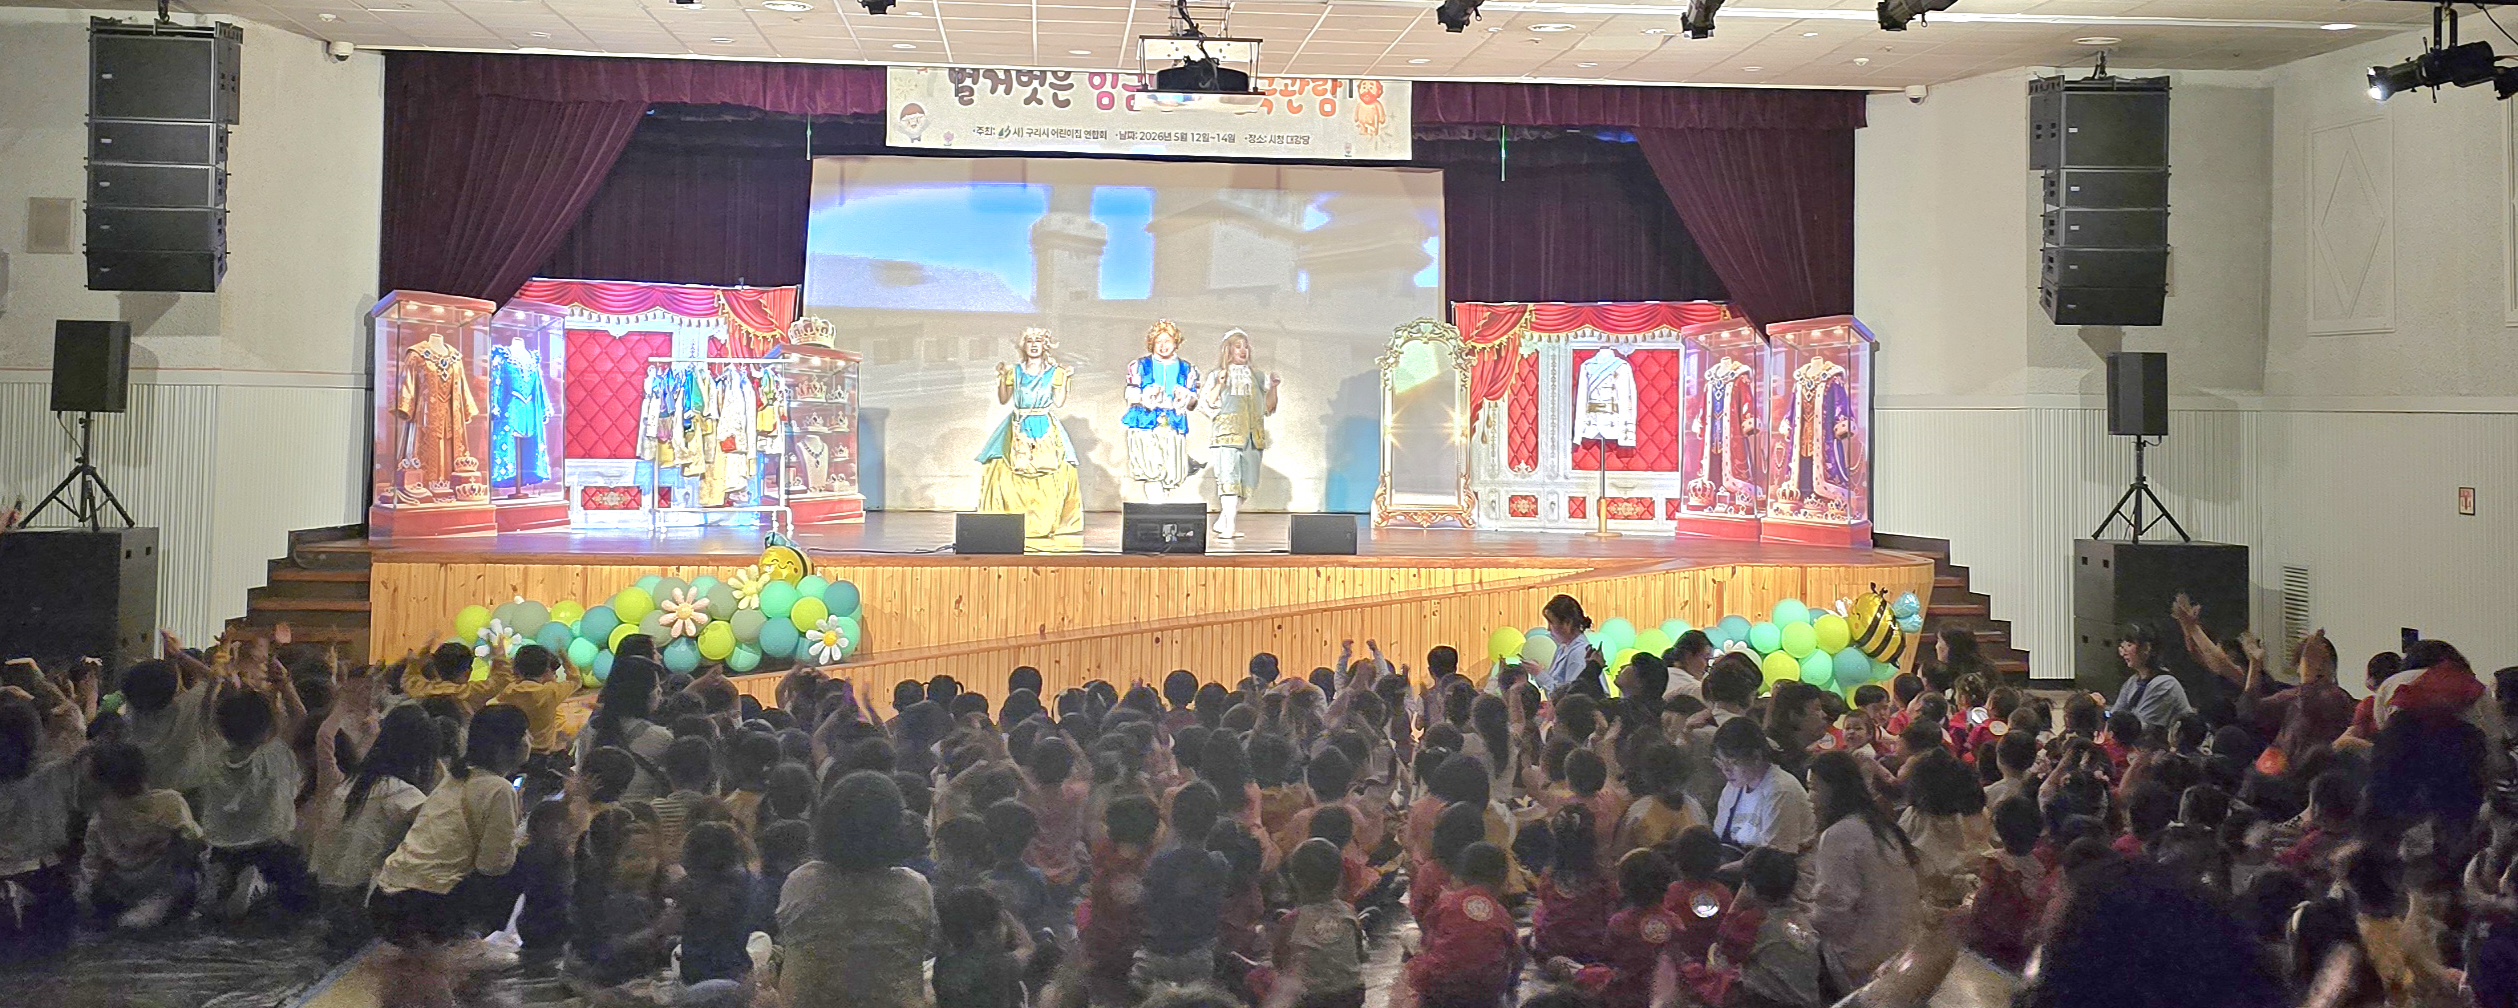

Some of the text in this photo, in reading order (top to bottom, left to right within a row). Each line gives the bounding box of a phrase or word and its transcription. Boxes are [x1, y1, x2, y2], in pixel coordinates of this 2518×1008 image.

[948, 67, 1075, 108] 벌거벗은
[1026, 127, 1049, 138] 구리시
[1051, 128, 1082, 139] 어린이집
[1084, 130, 1107, 140] 연합회
[1139, 131, 1172, 141] 2026년
[1174, 132, 1188, 142] 5월
[1191, 132, 1236, 143] 12일~14일
[1269, 134, 1285, 145] 시청
